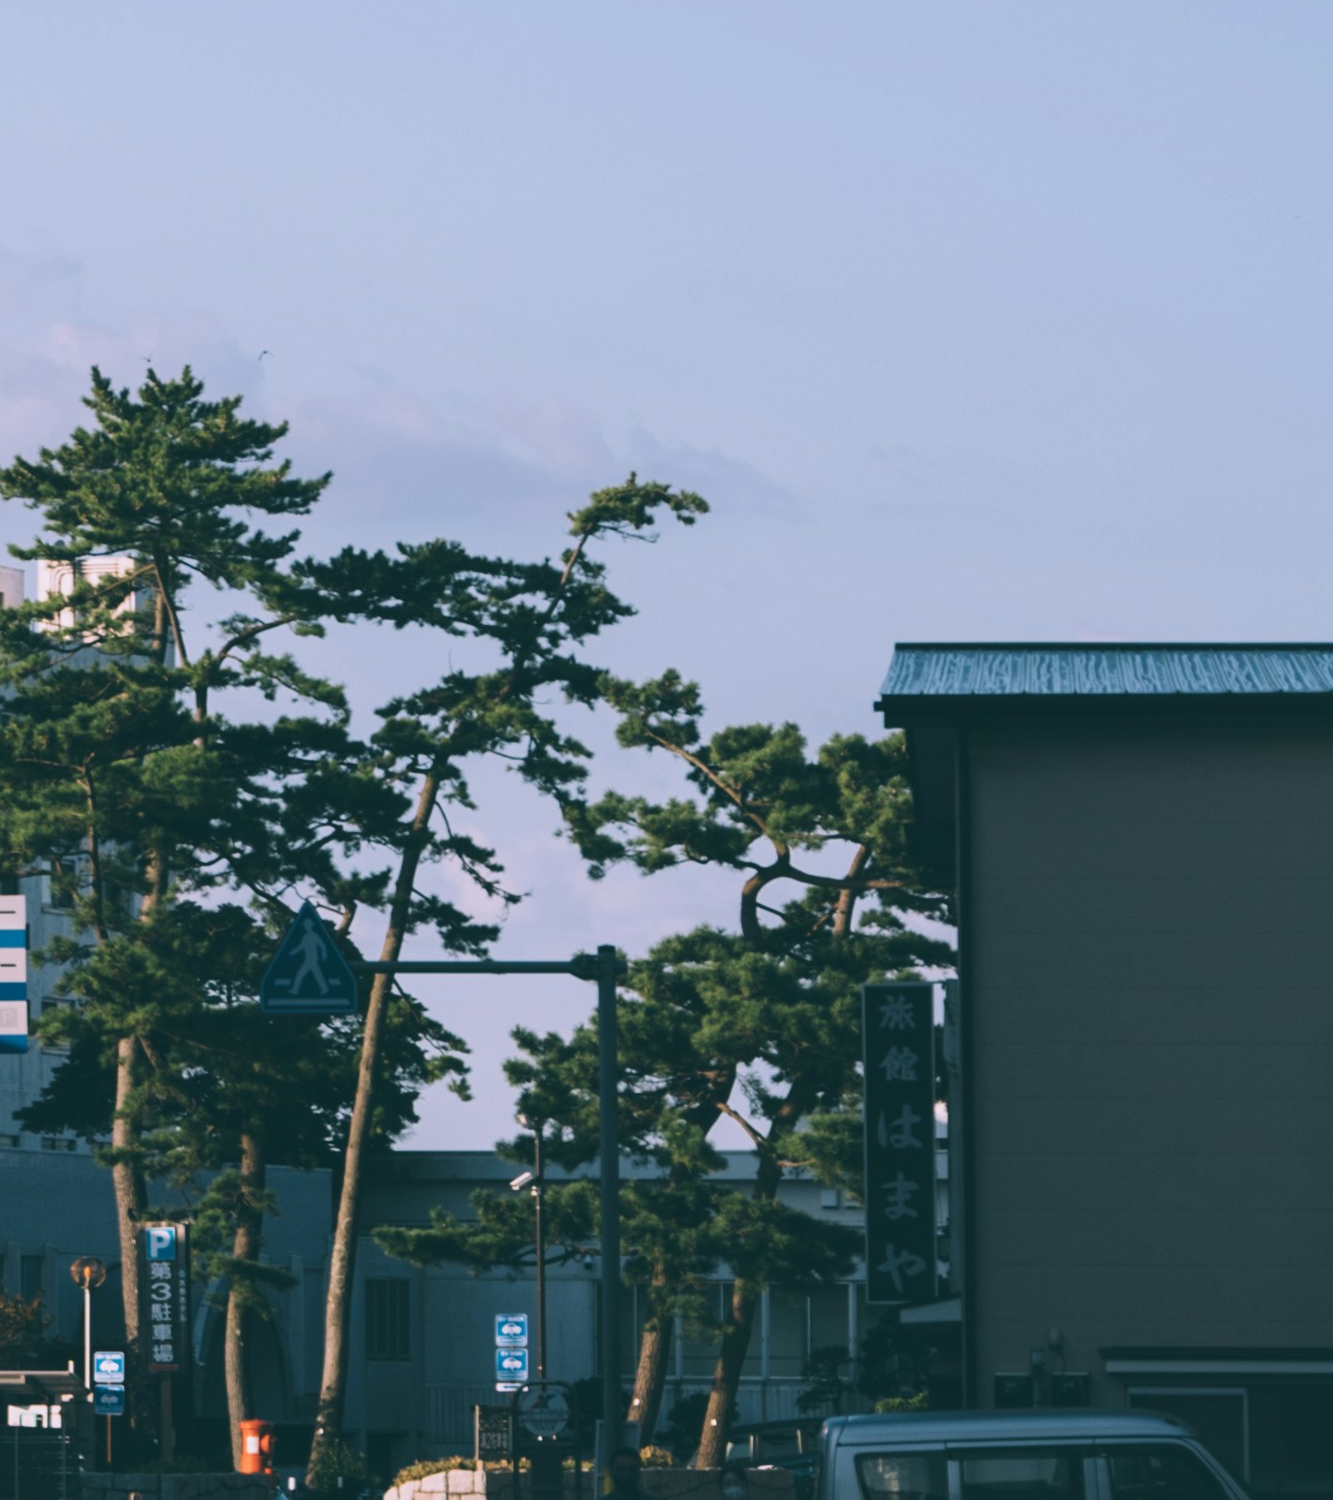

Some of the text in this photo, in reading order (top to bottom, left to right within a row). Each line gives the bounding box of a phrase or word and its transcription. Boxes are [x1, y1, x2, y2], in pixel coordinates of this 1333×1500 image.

[876, 995, 927, 1294] 旅館はまや
[149, 1230, 171, 1259] P
[149, 1261, 174, 1363] 第3駐車場
